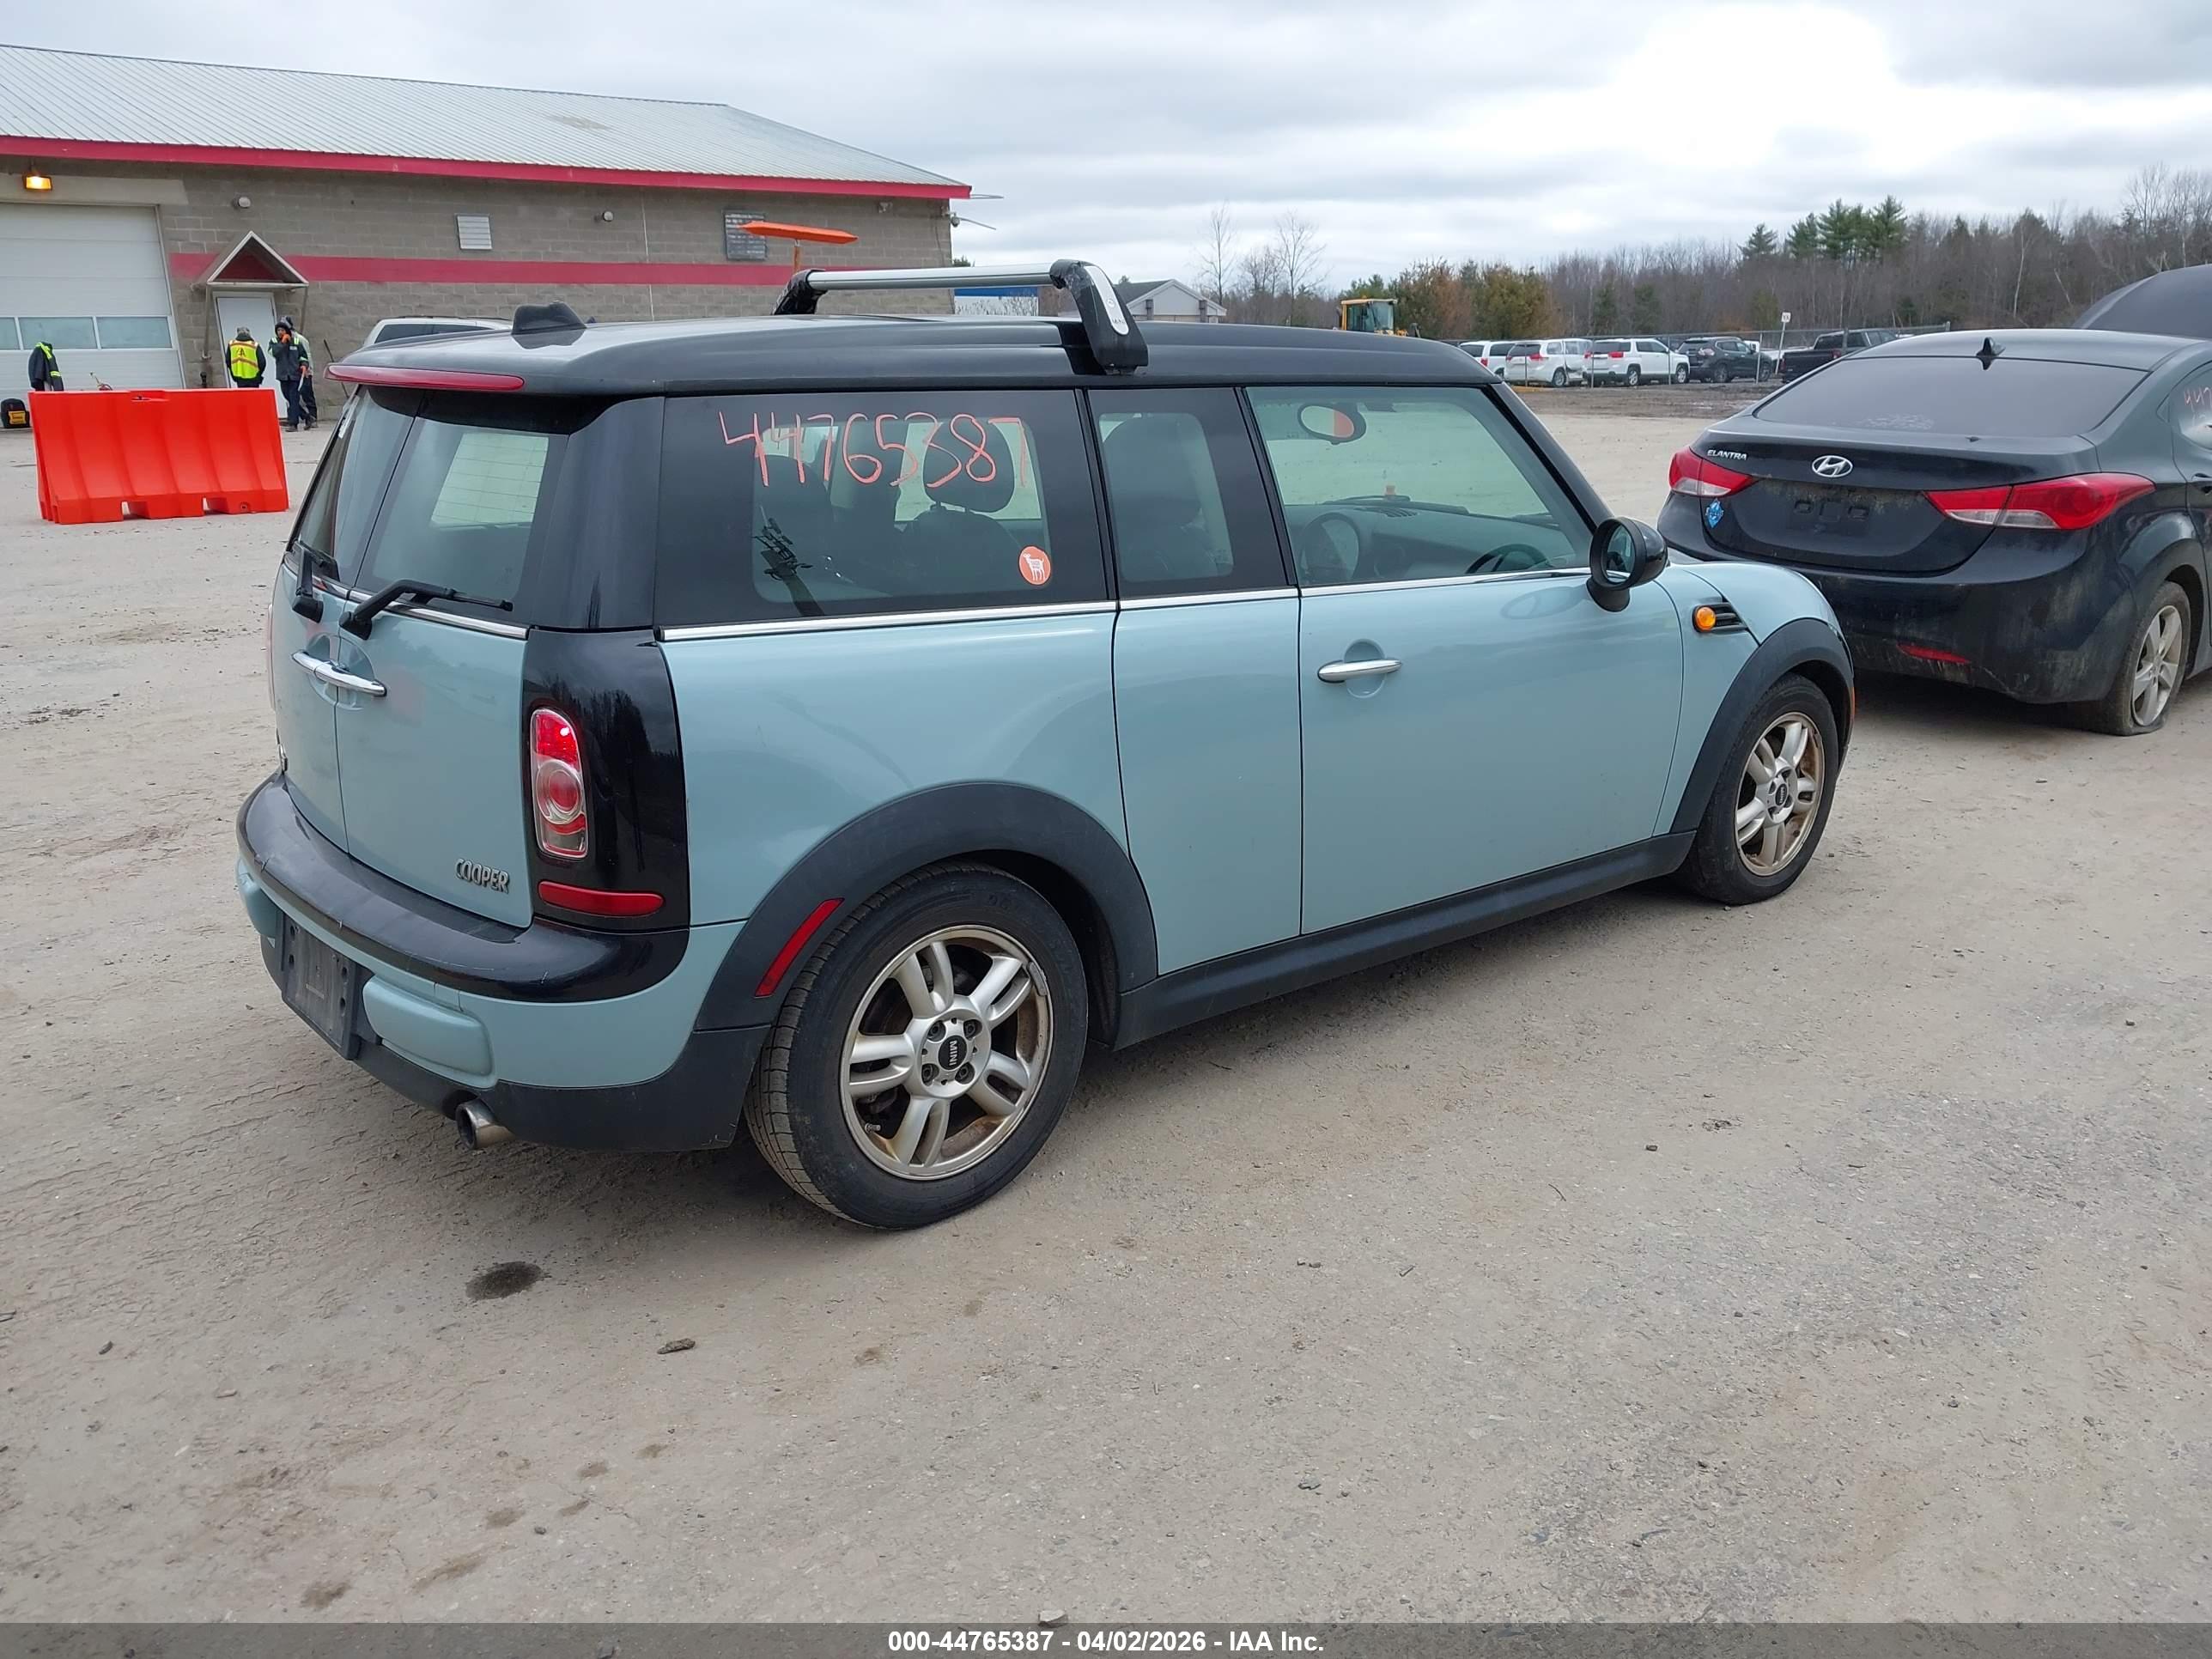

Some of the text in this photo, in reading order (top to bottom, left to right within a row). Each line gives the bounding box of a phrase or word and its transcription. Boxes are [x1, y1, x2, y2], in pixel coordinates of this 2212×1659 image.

[719, 411, 1027, 487] 44765387
[1707, 449, 1747, 460] ELANTRA
[455, 858, 509, 894] COOPER
[949, 1040, 958, 1066] MINI
